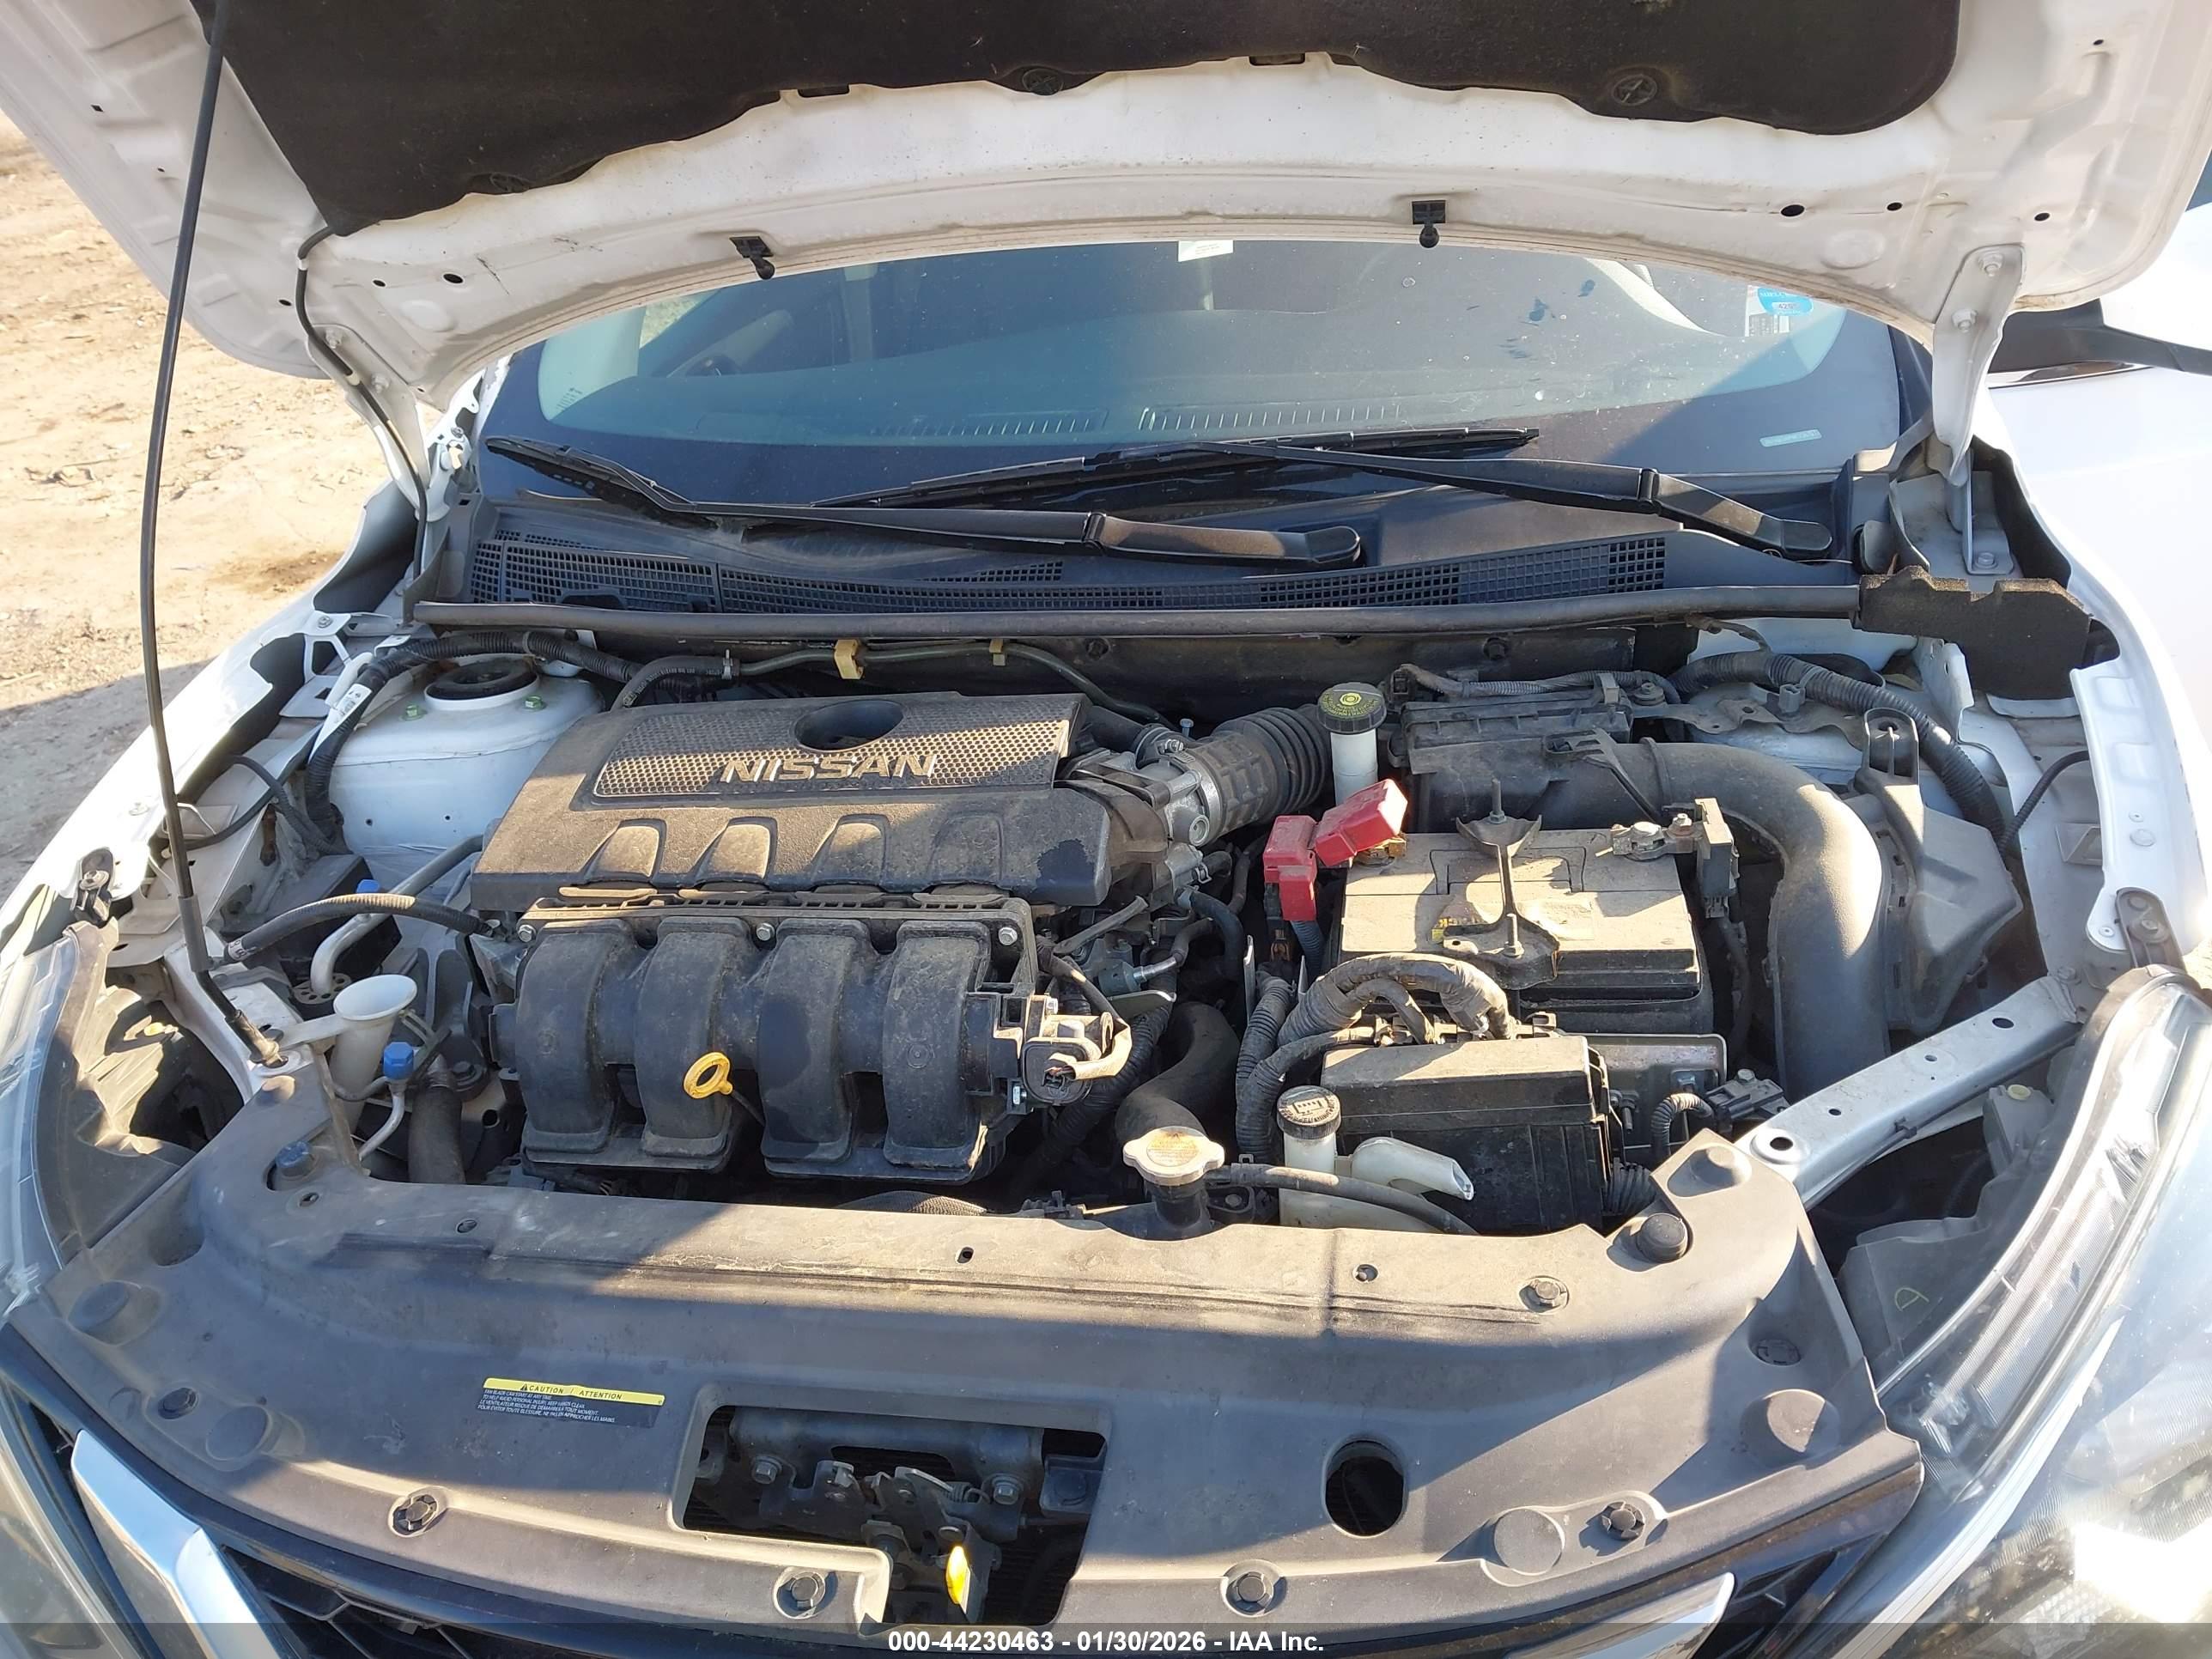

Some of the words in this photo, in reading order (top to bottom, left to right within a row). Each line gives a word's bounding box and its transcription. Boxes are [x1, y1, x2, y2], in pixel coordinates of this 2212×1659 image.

[720, 754, 937, 783] NISSAN
[529, 1385, 564, 1394] CAUTION
[579, 1390, 623, 1400] ATTENTION
